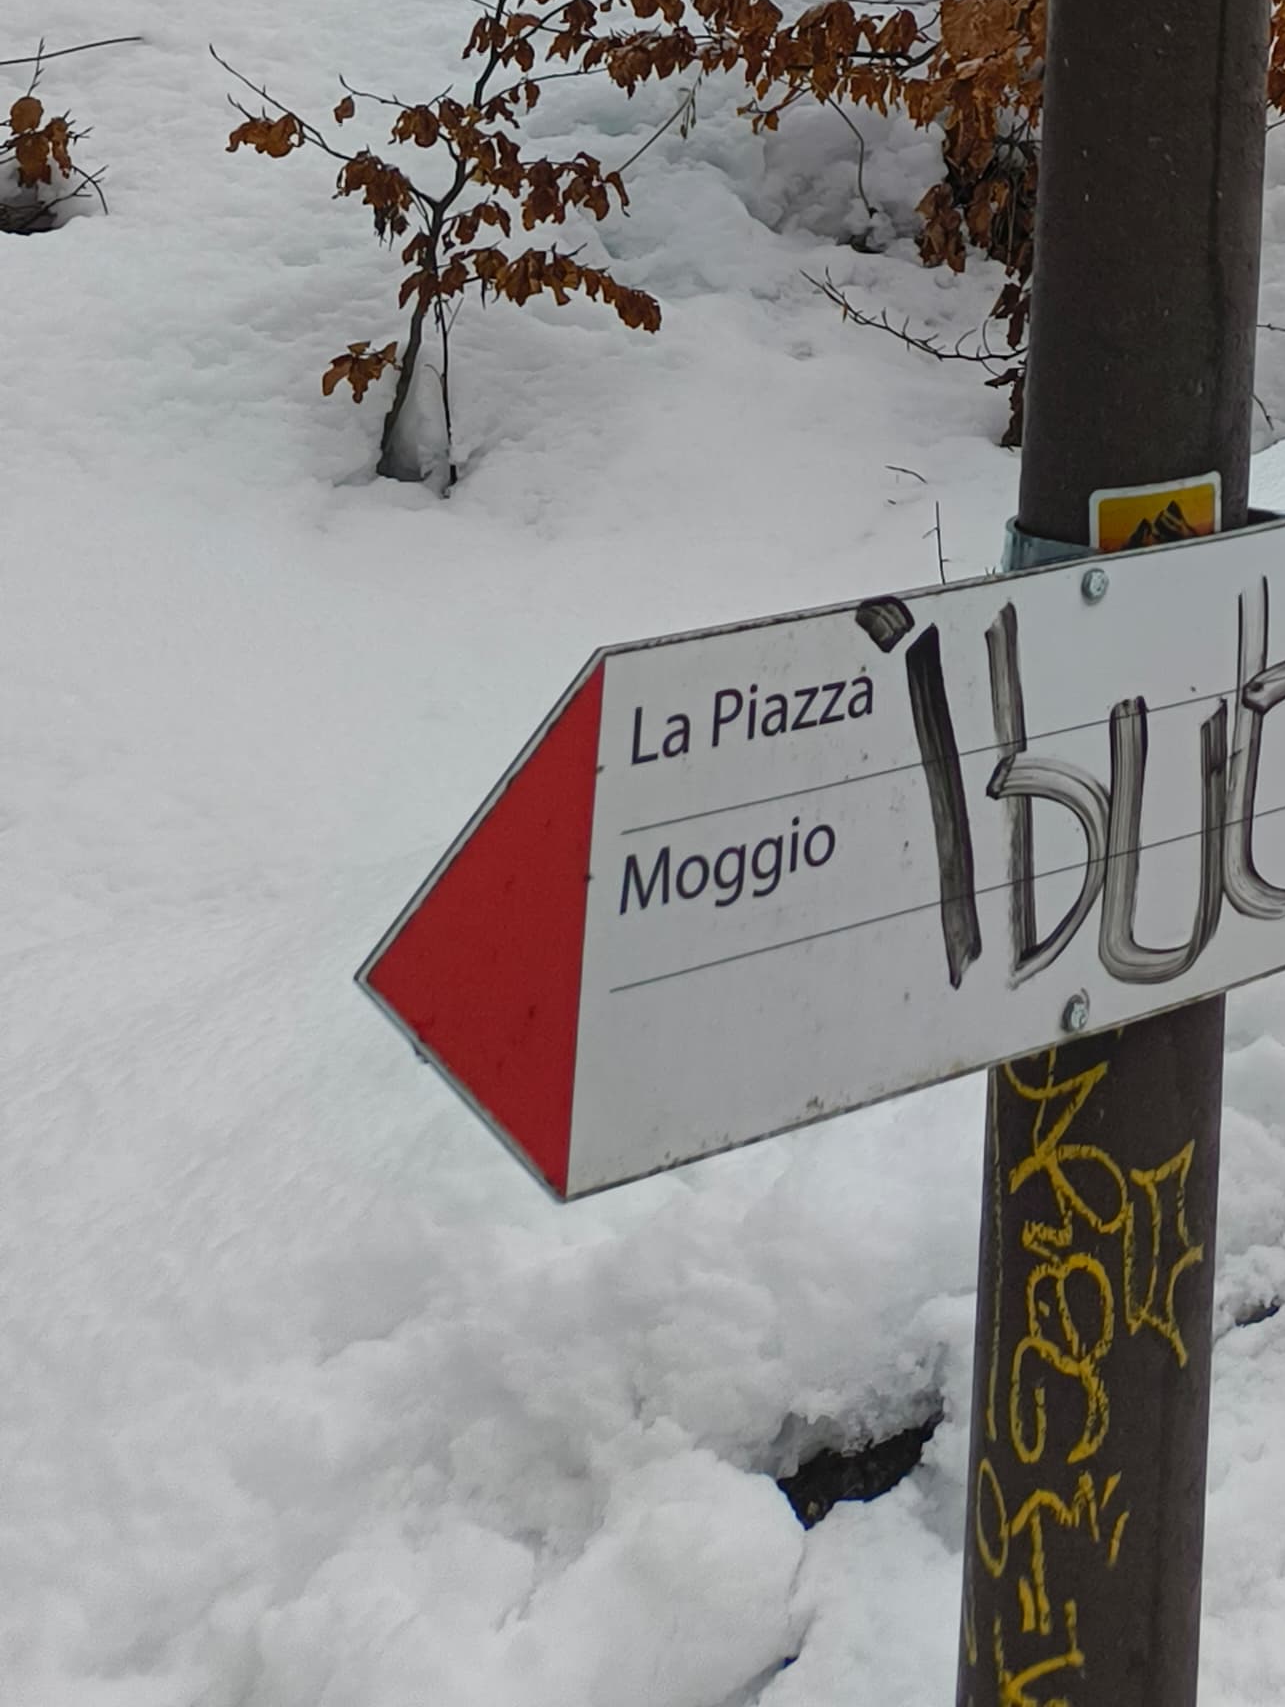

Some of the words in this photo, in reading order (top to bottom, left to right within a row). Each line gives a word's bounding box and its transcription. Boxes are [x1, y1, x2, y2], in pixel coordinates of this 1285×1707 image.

[630, 706, 691, 767] La
[711, 675, 874, 749] Piazza
[619, 815, 836, 916] Moggio
